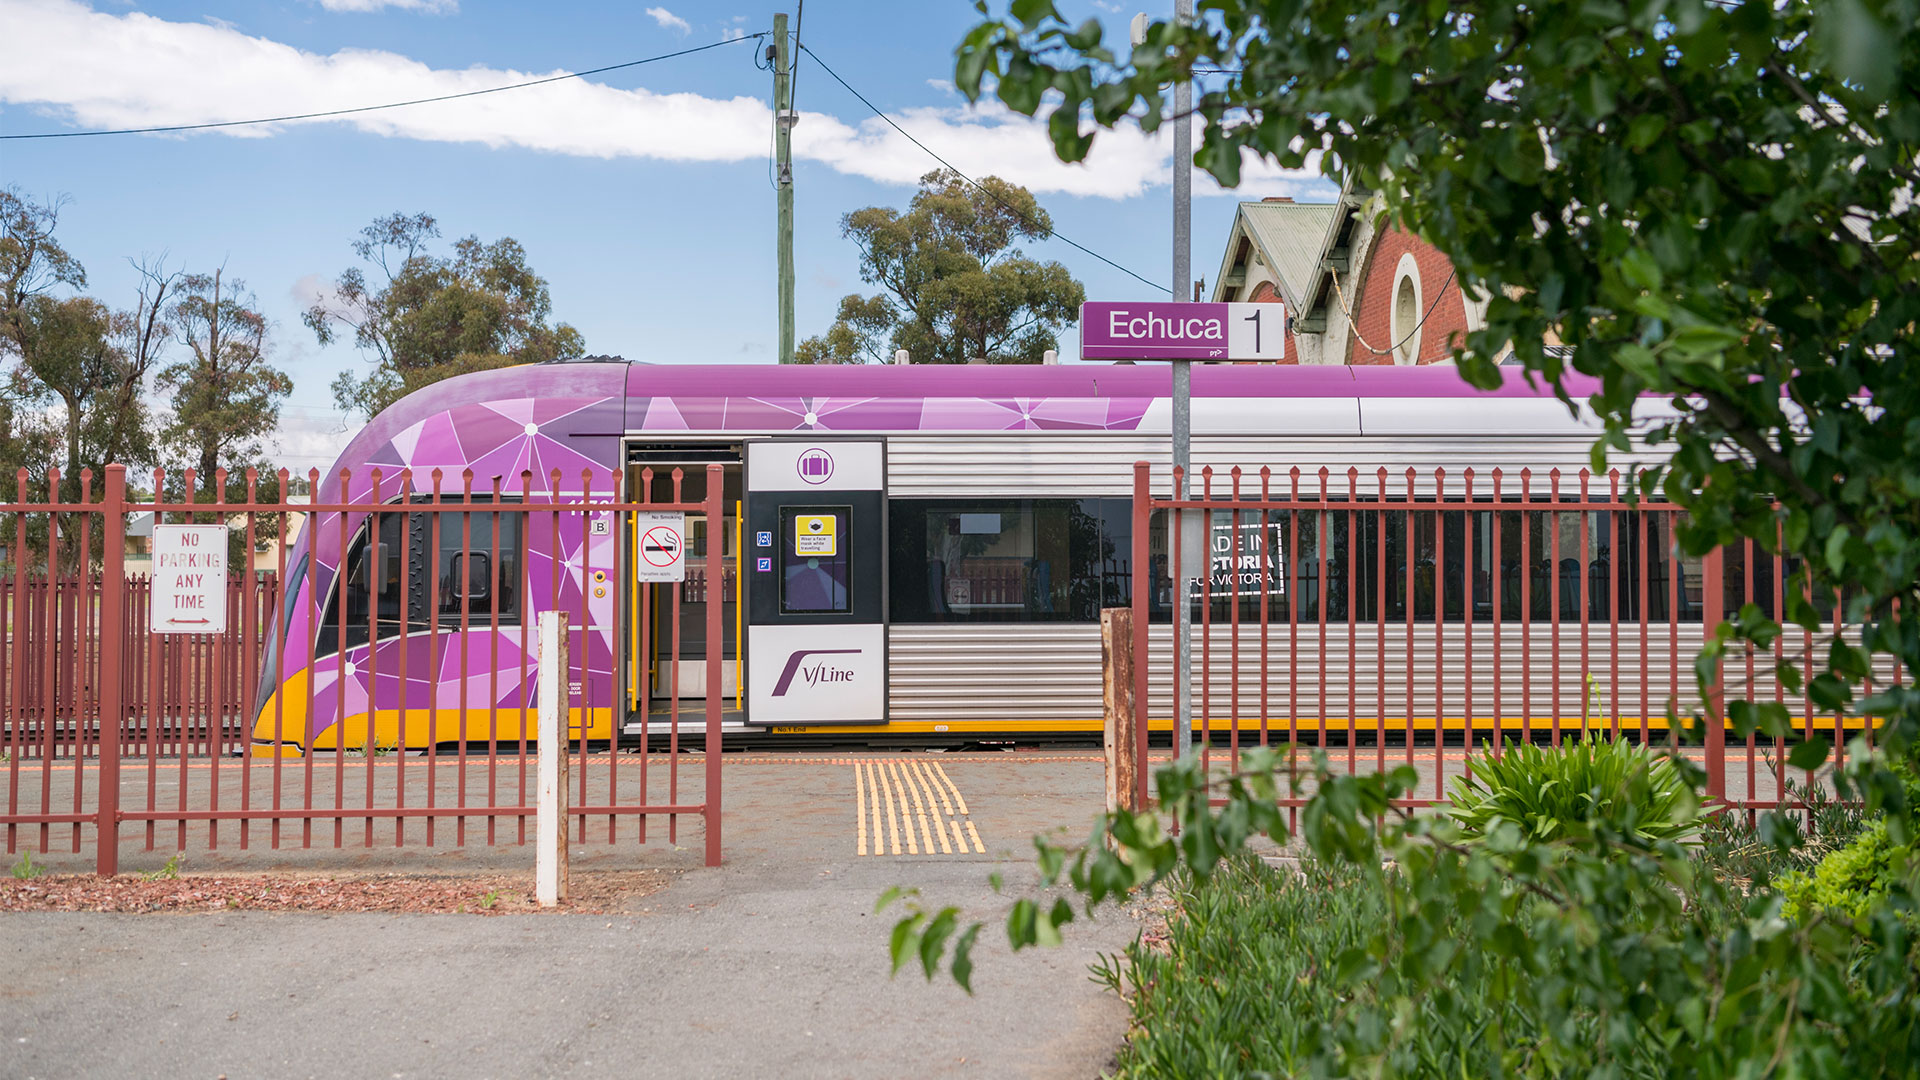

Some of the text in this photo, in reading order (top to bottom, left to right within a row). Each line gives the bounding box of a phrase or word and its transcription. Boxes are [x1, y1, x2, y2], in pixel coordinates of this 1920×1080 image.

[1109, 309, 1260, 353] Echuca 1
[596, 522, 605, 532] B
[181, 532, 200, 547] NO
[160, 553, 220, 567] PARKING
[175, 573, 204, 588] ANY
[173, 594, 206, 609] TIME
